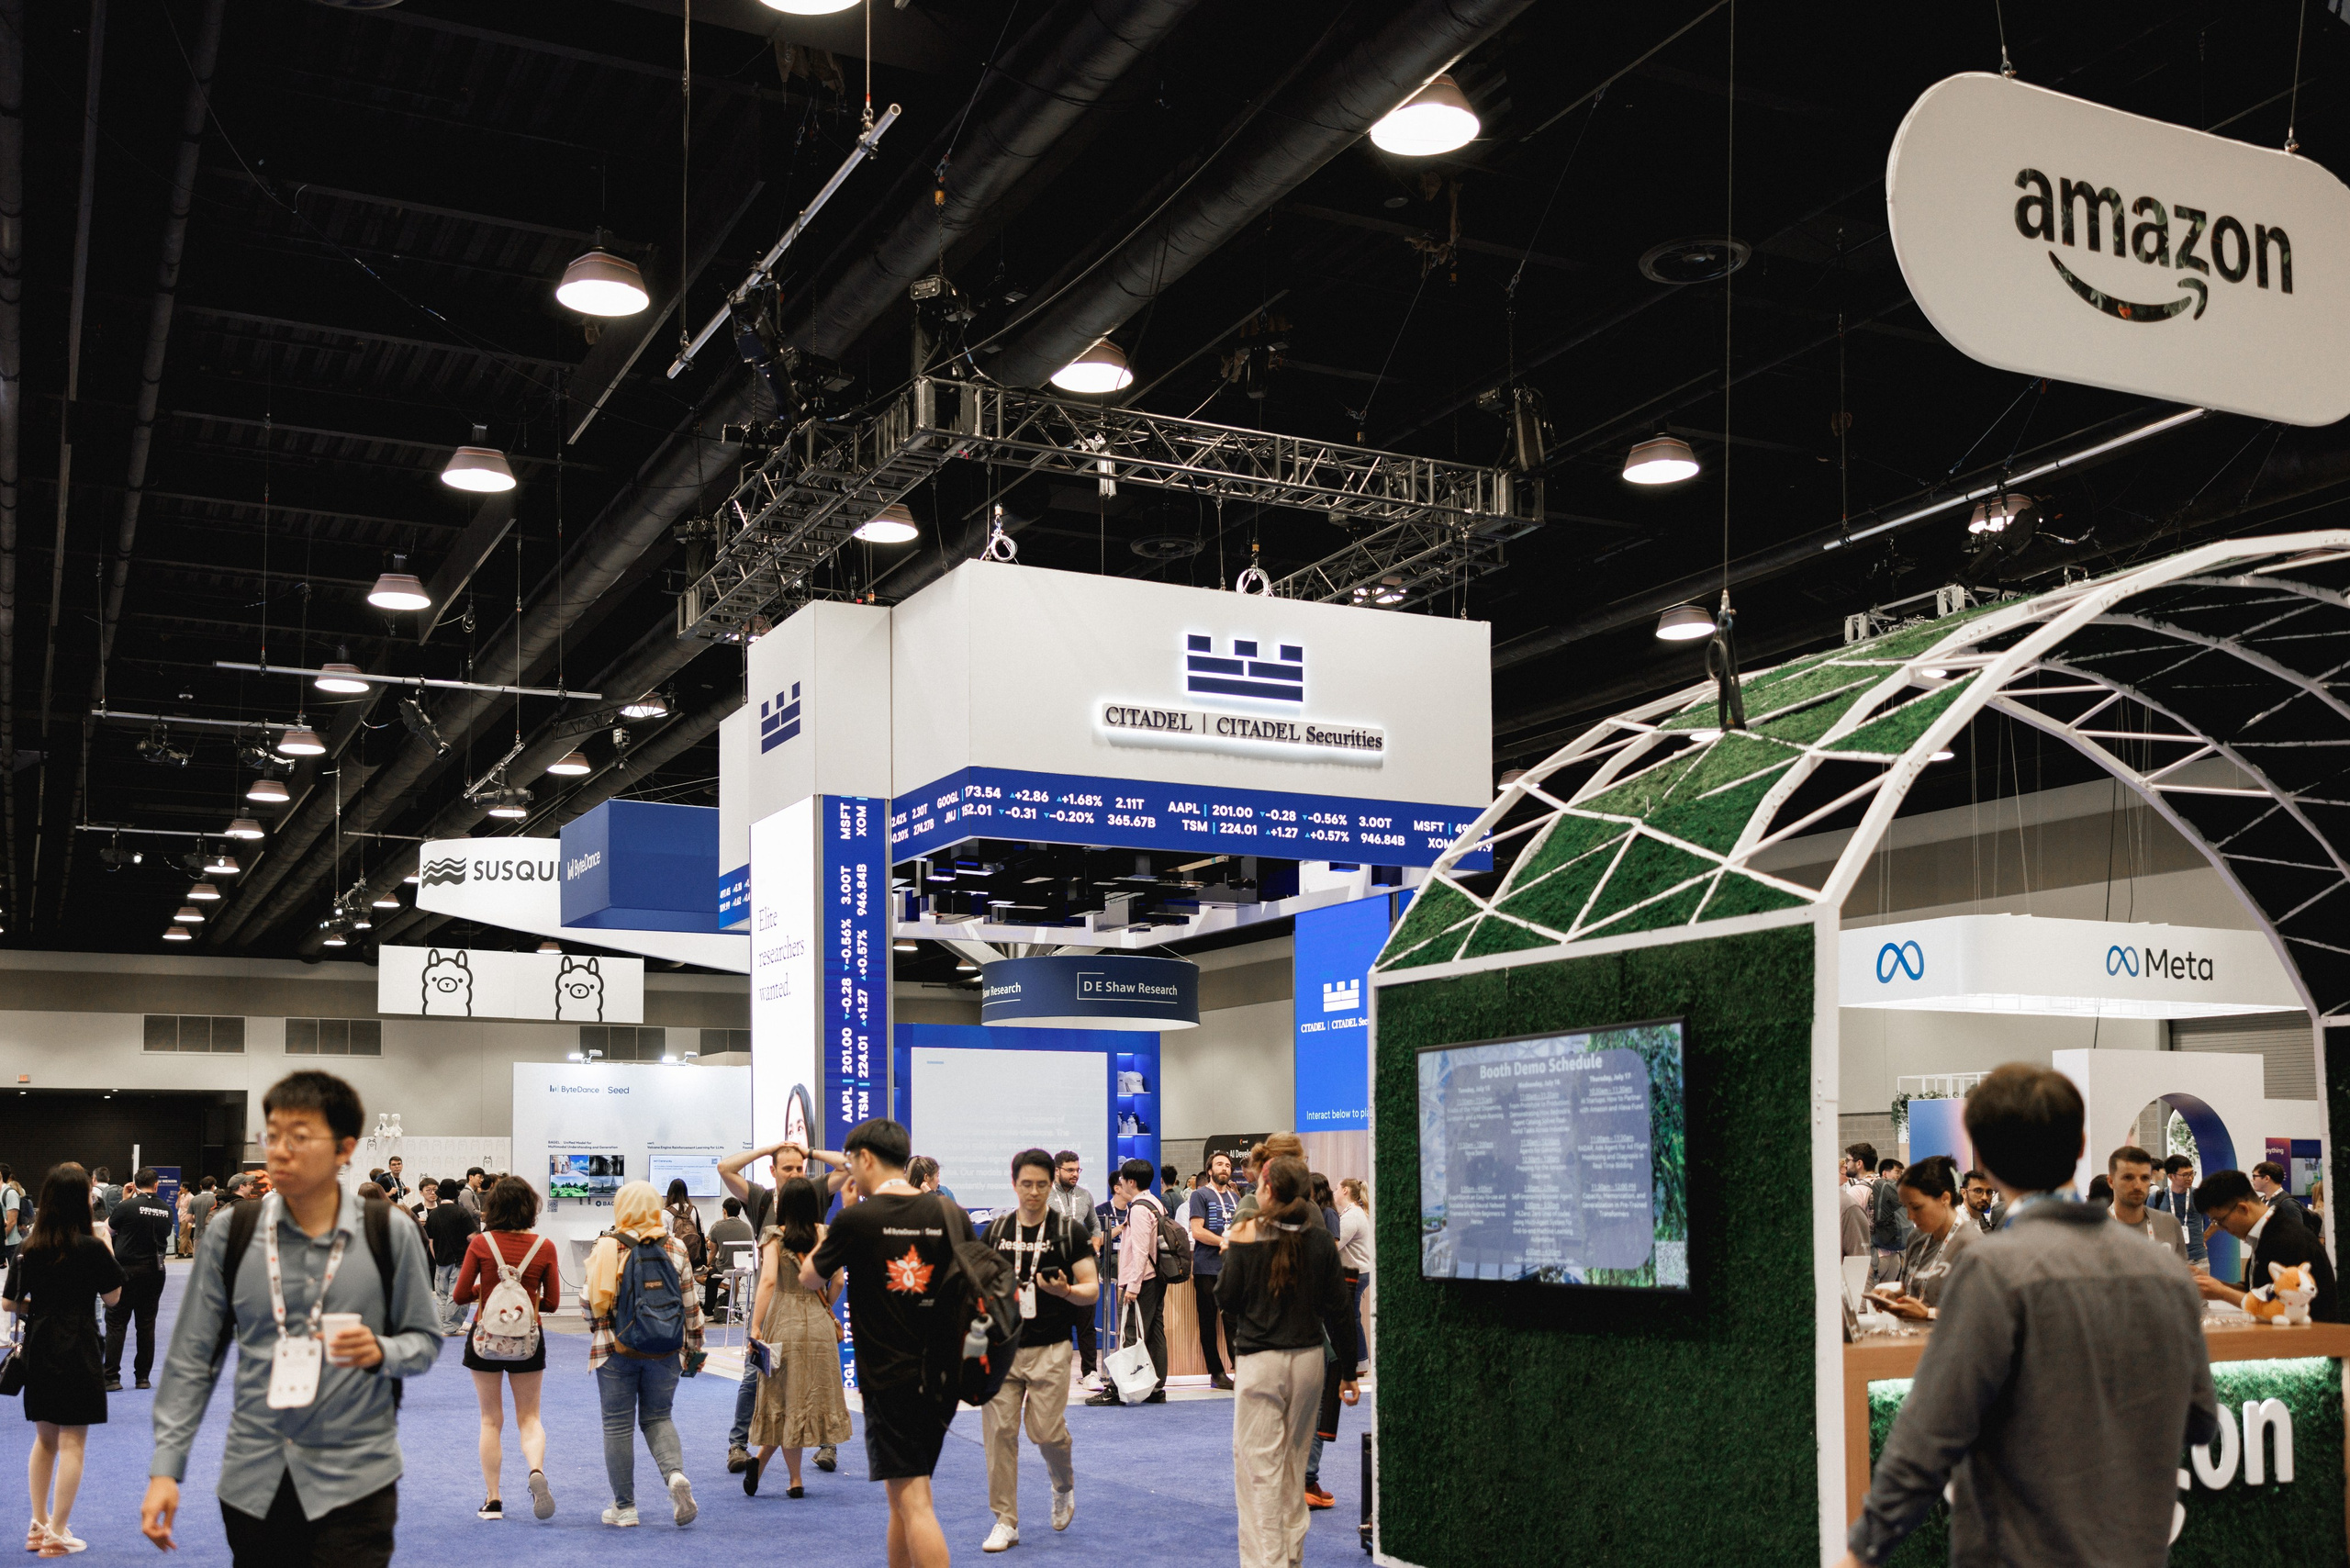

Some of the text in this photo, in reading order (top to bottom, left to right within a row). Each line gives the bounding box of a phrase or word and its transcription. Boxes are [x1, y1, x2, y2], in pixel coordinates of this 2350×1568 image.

[2013, 167, 2294, 295] amazon
[1105, 706, 1383, 749] CITADEL CITADEL Securities
[937, 790, 959, 809] GOOGL
[964, 785, 1002, 799] 173.54
[1015, 790, 1049, 802] +2.86
[1062, 793, 1103, 807] +1.68%
[1115, 797, 1145, 811] 2.11T
[1168, 801, 1201, 815] AAPL
[1212, 805, 1253, 818] 201.00
[1265, 809, 1297, 822] -0.28
[1307, 812, 1348, 826] -0.56%
[1359, 816, 1392, 829] 3.00T
[1413, 820, 1444, 833] MSFT
[945, 809, 957, 823] JNJ
[961, 804, 992, 818] 152.01
[1005, 807, 1036, 820] -0.31
[1049, 810, 1095, 824] -0.20%
[1107, 814, 1157, 828] 365.67B
[1182, 819, 1208, 833] TSM
[1219, 823, 1258, 835] 224.01
[1270, 827, 1298, 839] +1.27
[1310, 830, 1350, 843] +0.57%
[1360, 833, 1405, 846] 946.84B
[574, 850, 601, 879] ByteDance
[758, 906, 778, 932] Elite
[758, 935, 805, 968] researchers
[840, 803, 854, 1124] AAPL 201.00 -0.28 -0.56% 3.00T MSFT
[856, 806, 869, 1120] TSM 224.01 +1.27 +0.57% 946.84B XOM
[2144, 947, 2213, 980] Meta
[759, 972, 791, 1002] wanted.
[990, 981, 1022, 996] Research
[1083, 980, 1178, 996] D E Shaw Research
[1301, 1022, 1326, 1033] CITADEL
[1331, 1018, 1358, 1030] CITADEL
[1480, 1053, 1602, 1079] Booth Demo Schedule
[1589, 1075, 1613, 1083] Thursday,
[1614, 1072, 1624, 1081] July
[561, 1085, 630, 1094] ByteDance Seed
[1306, 1111, 1331, 1121] Interact
[1331, 1109, 1351, 1119] below
[1352, 1109, 1360, 1118] to
[1230, 1149, 1235, 1159] AI
[140, 1206, 170, 1215] GENESIS
